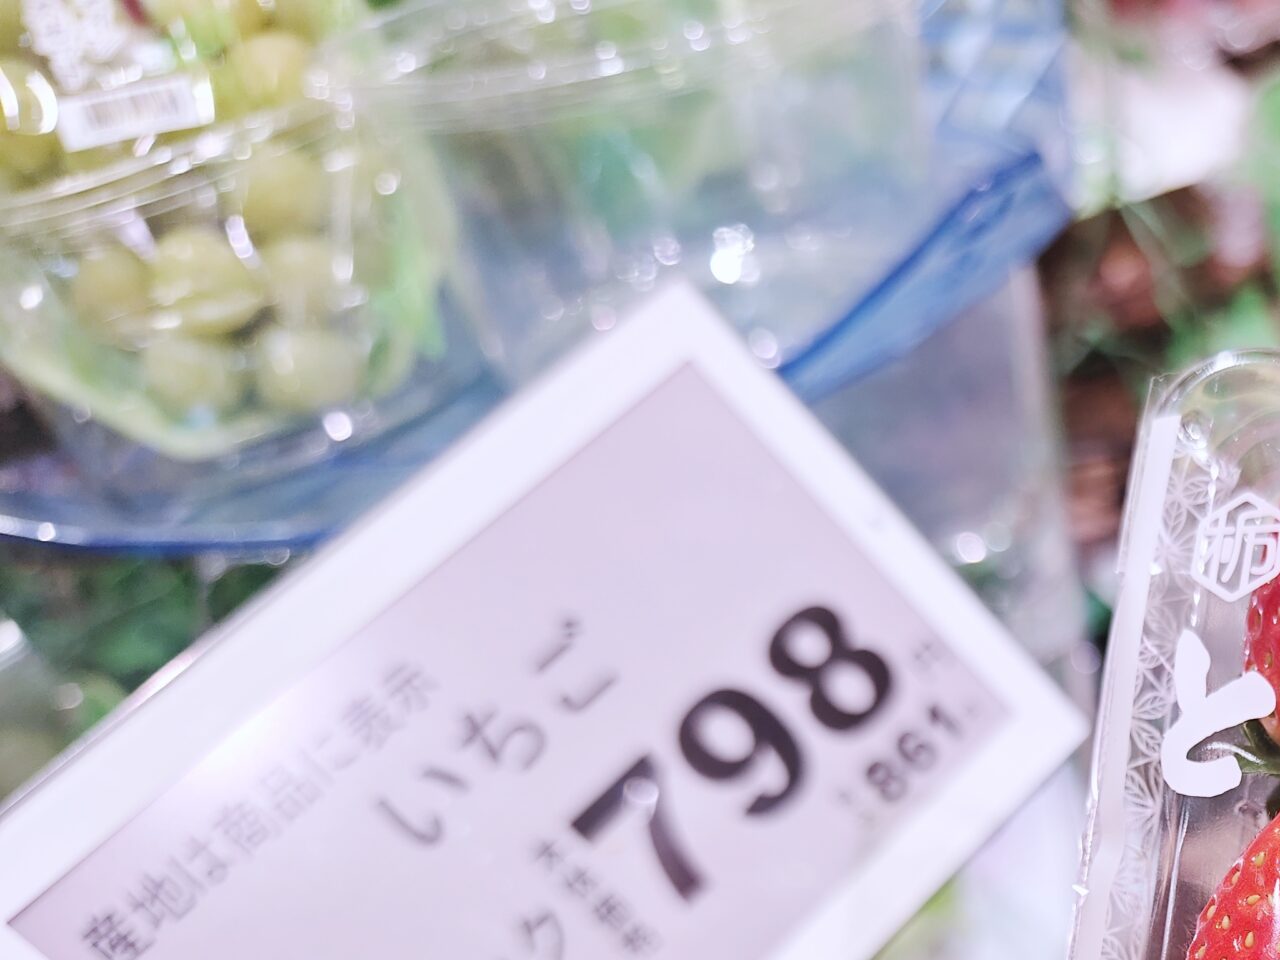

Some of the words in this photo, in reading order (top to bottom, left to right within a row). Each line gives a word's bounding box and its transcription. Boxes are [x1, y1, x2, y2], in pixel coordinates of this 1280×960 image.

[376, 615, 619, 846] いちご
[570, 605, 893, 903] 798
